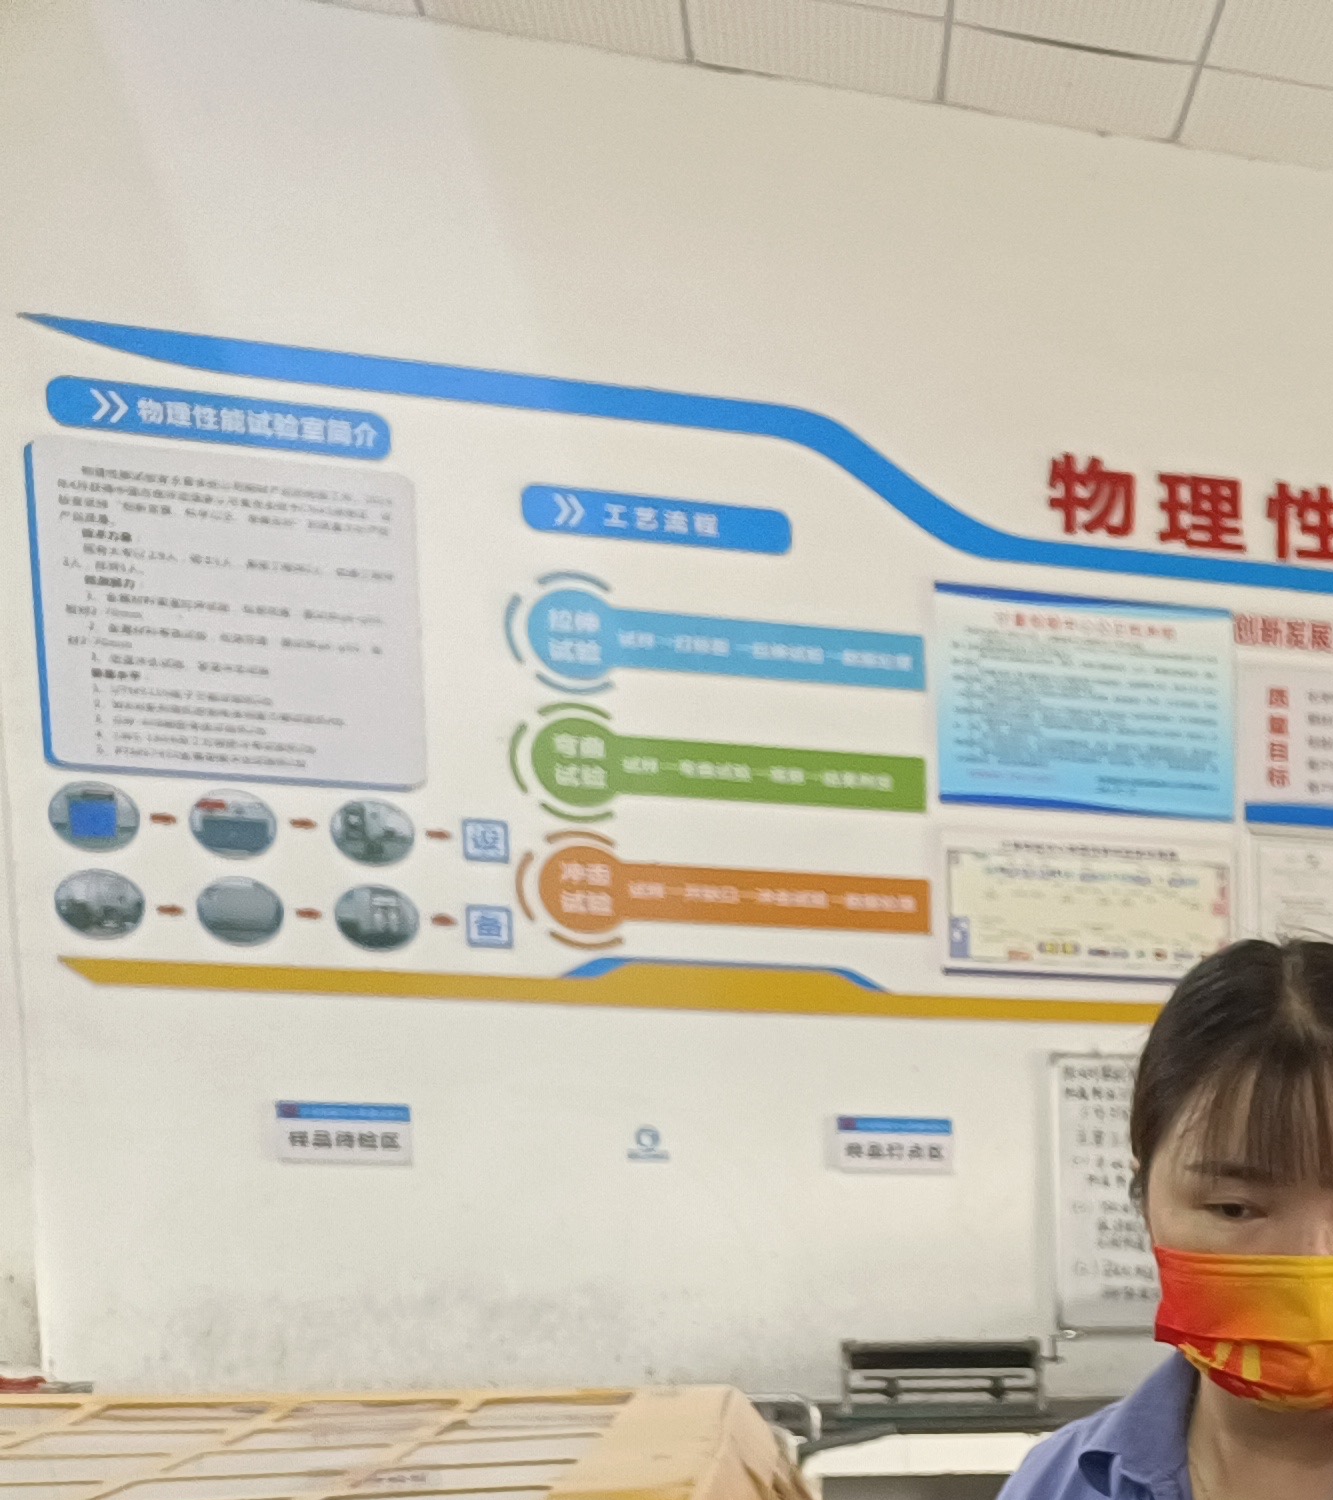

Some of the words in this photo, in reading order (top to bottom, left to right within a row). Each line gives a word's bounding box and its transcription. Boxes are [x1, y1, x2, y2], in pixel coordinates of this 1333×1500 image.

[136, 396, 378, 448] 物理性能试验室简介
[603, 503, 719, 538] 工艺流程
